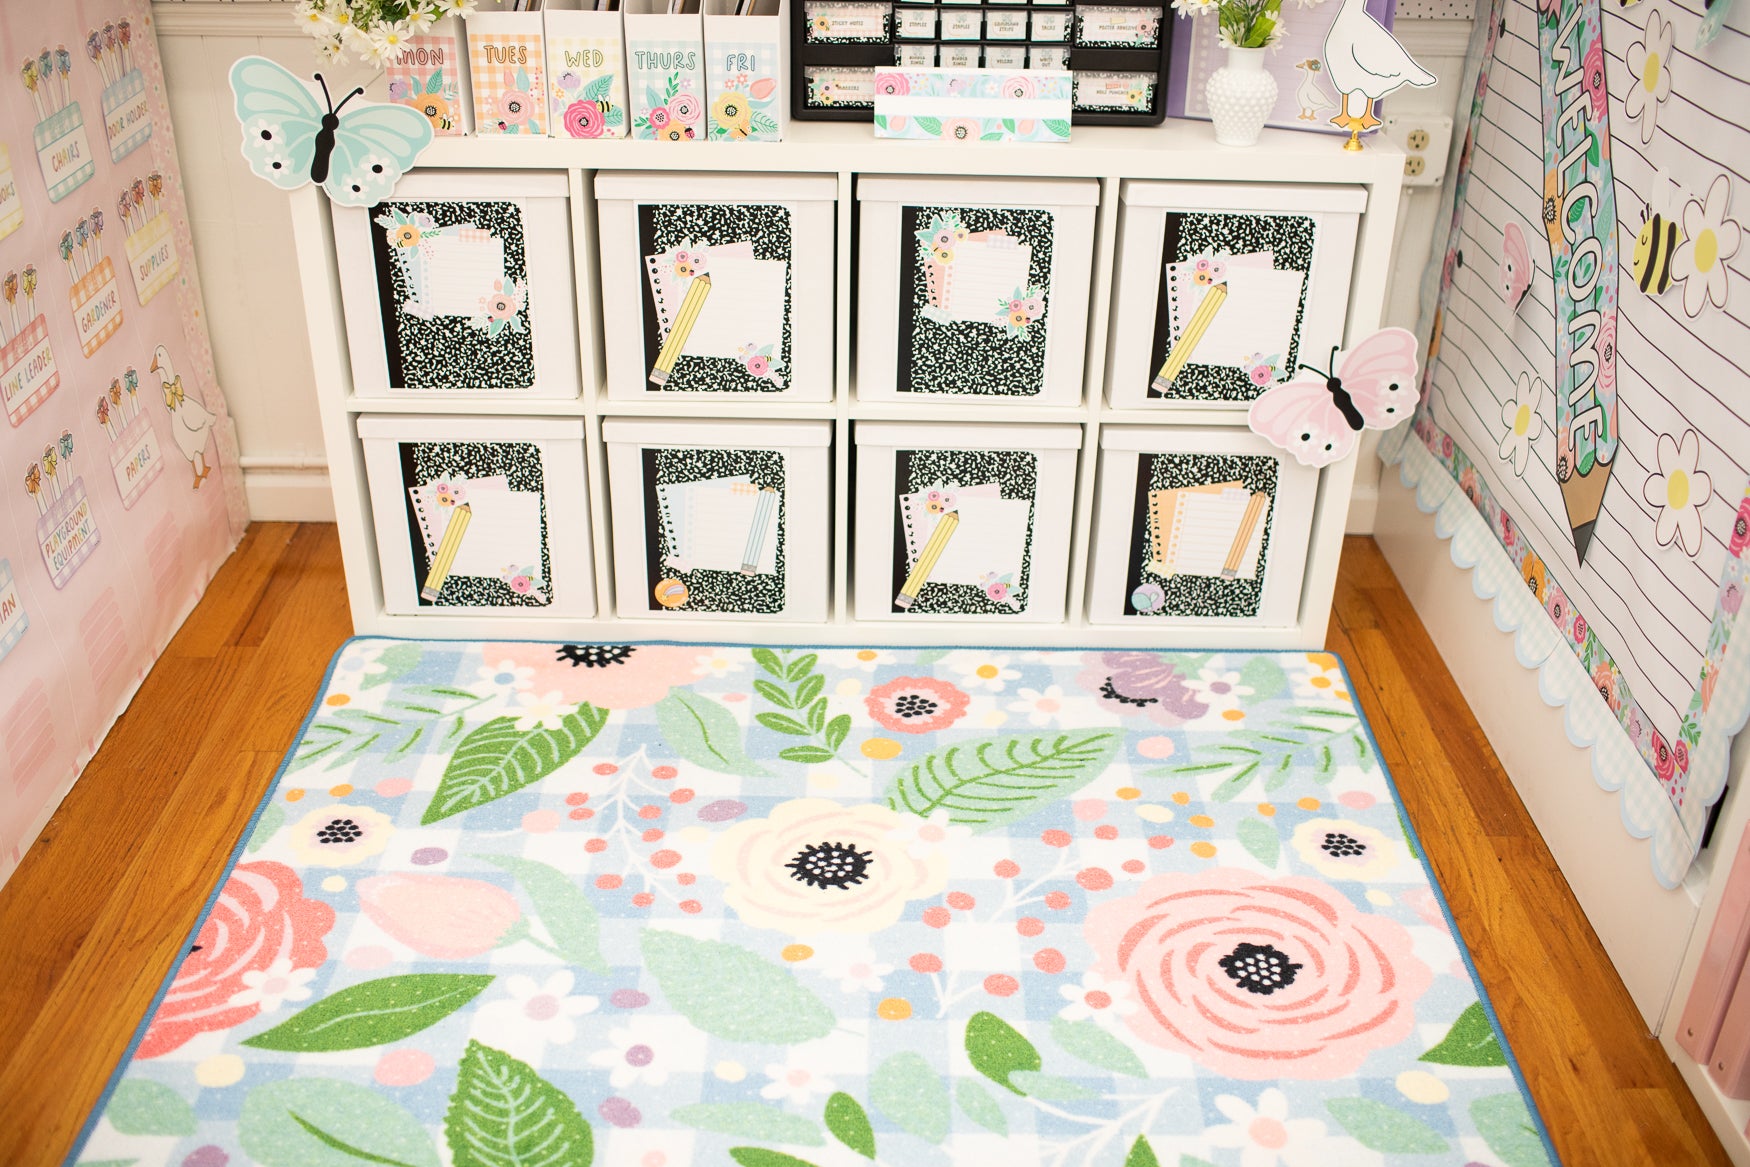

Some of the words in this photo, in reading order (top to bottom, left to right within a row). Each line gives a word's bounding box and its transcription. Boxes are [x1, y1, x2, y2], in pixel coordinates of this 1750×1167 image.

[396, 47, 444, 66] MON
[483, 44, 528, 65] TUES
[564, 49, 604, 68] WED
[634, 50, 696, 70] THURS
[726, 52, 756, 72] FRI
[108, 116, 126, 141] DOOR
[126, 100, 149, 127] HOLDER
[51, 140, 81, 173] CHAIRS
[1551, 3, 1604, 453] WELCOME
[139, 244, 169, 282] SUPPLIES
[81, 289, 117, 334] GARDENER
[3, 371, 24, 402] LINE
[25, 346, 53, 384] LEADER
[125, 444, 151, 482] PAPERS
[44, 500, 89, 559] PLAYGROUND
[53, 517, 91, 571] EQUIPMENT
